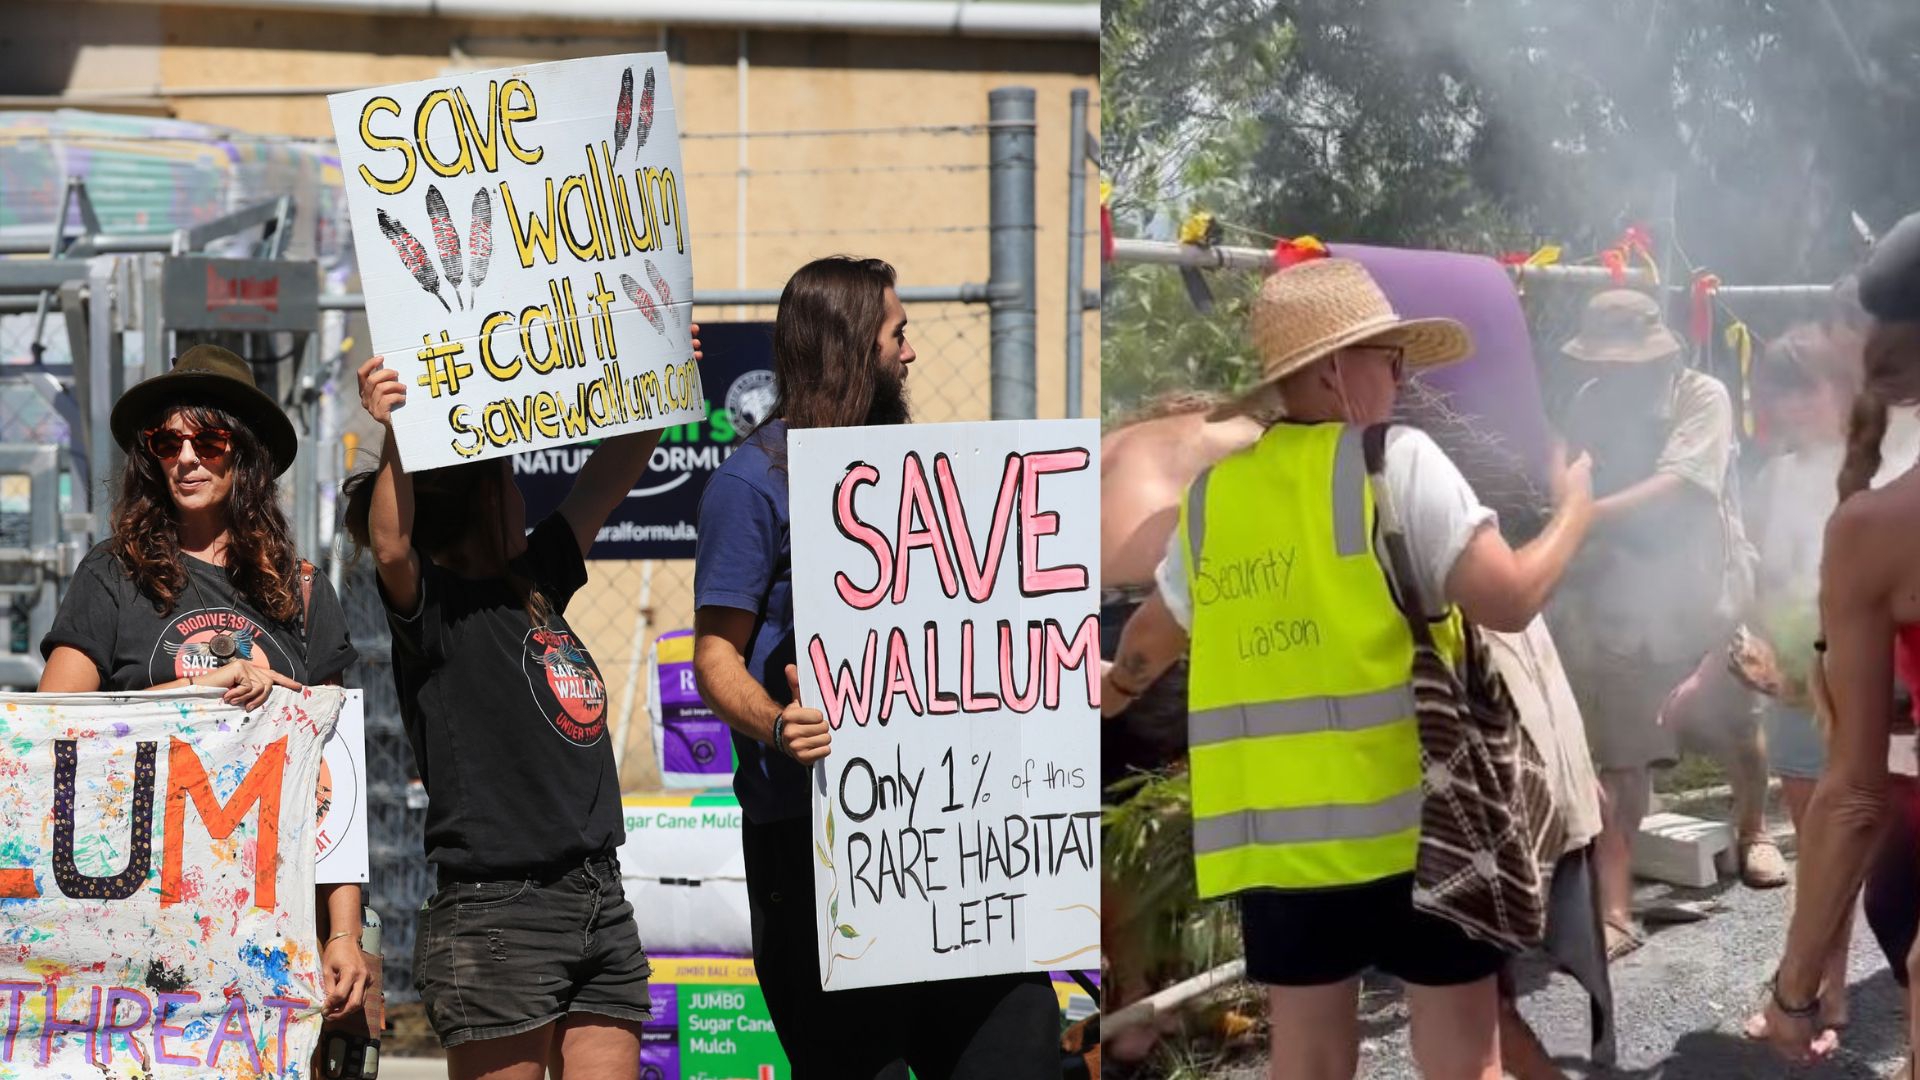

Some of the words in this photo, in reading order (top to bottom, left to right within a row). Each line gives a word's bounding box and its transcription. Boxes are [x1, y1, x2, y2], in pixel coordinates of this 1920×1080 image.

[358, 79, 543, 195] save
[500, 140, 684, 268] wallum
[448, 357, 703, 459] savewallum.com
[649, 447, 738, 471] ORMU
[832, 447, 1090, 610] SAVE
[1196, 545, 1297, 606] Security
[176, 612, 263, 638] BIODIVERSITY
[1238, 618, 1320, 660] Liaison
[182, 654, 218, 669] SAVE
[550, 663, 579, 679] SAVE
[808, 614, 1100, 730] WALLUM
[839, 743, 925, 828] Only
[1011, 758, 1035, 798] of
[1042, 761, 1085, 790] this
[625, 815, 652, 832] gar
[656, 812, 697, 829] Cane
[701, 812, 742, 829] Mulc
[847, 826, 947, 908] RARE
[958, 811, 1100, 888] HABITAT
[932, 892, 1028, 954] LEFT
[0, 980, 310, 1077] THREAT
[688, 993, 745, 1010] JUMBO
[688, 1014, 733, 1035] Sugar
[689, 1037, 737, 1054] Mulch
